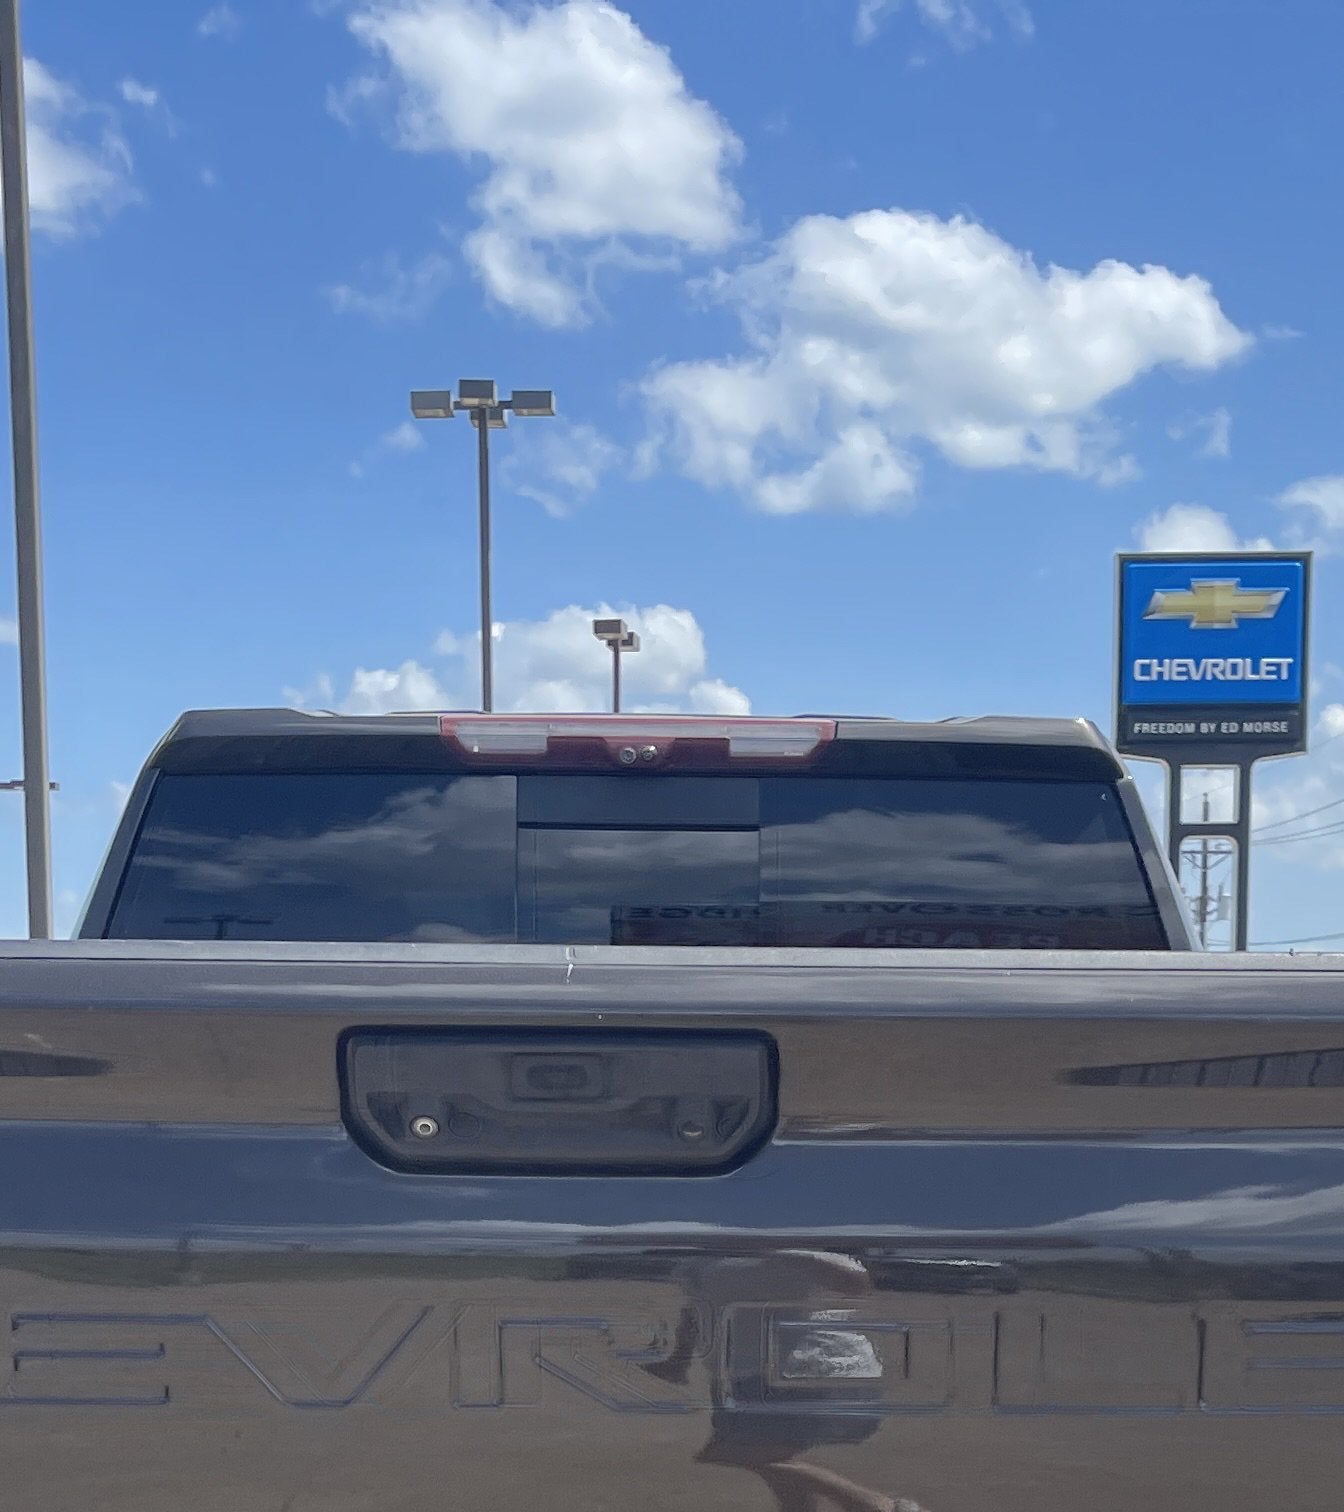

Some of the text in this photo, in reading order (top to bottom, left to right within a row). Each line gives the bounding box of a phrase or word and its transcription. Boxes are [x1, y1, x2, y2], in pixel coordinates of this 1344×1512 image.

[1134, 658, 1294, 681] CHEVROLET
[1133, 721, 1289, 735] FREEDOM BY ED MORSE
